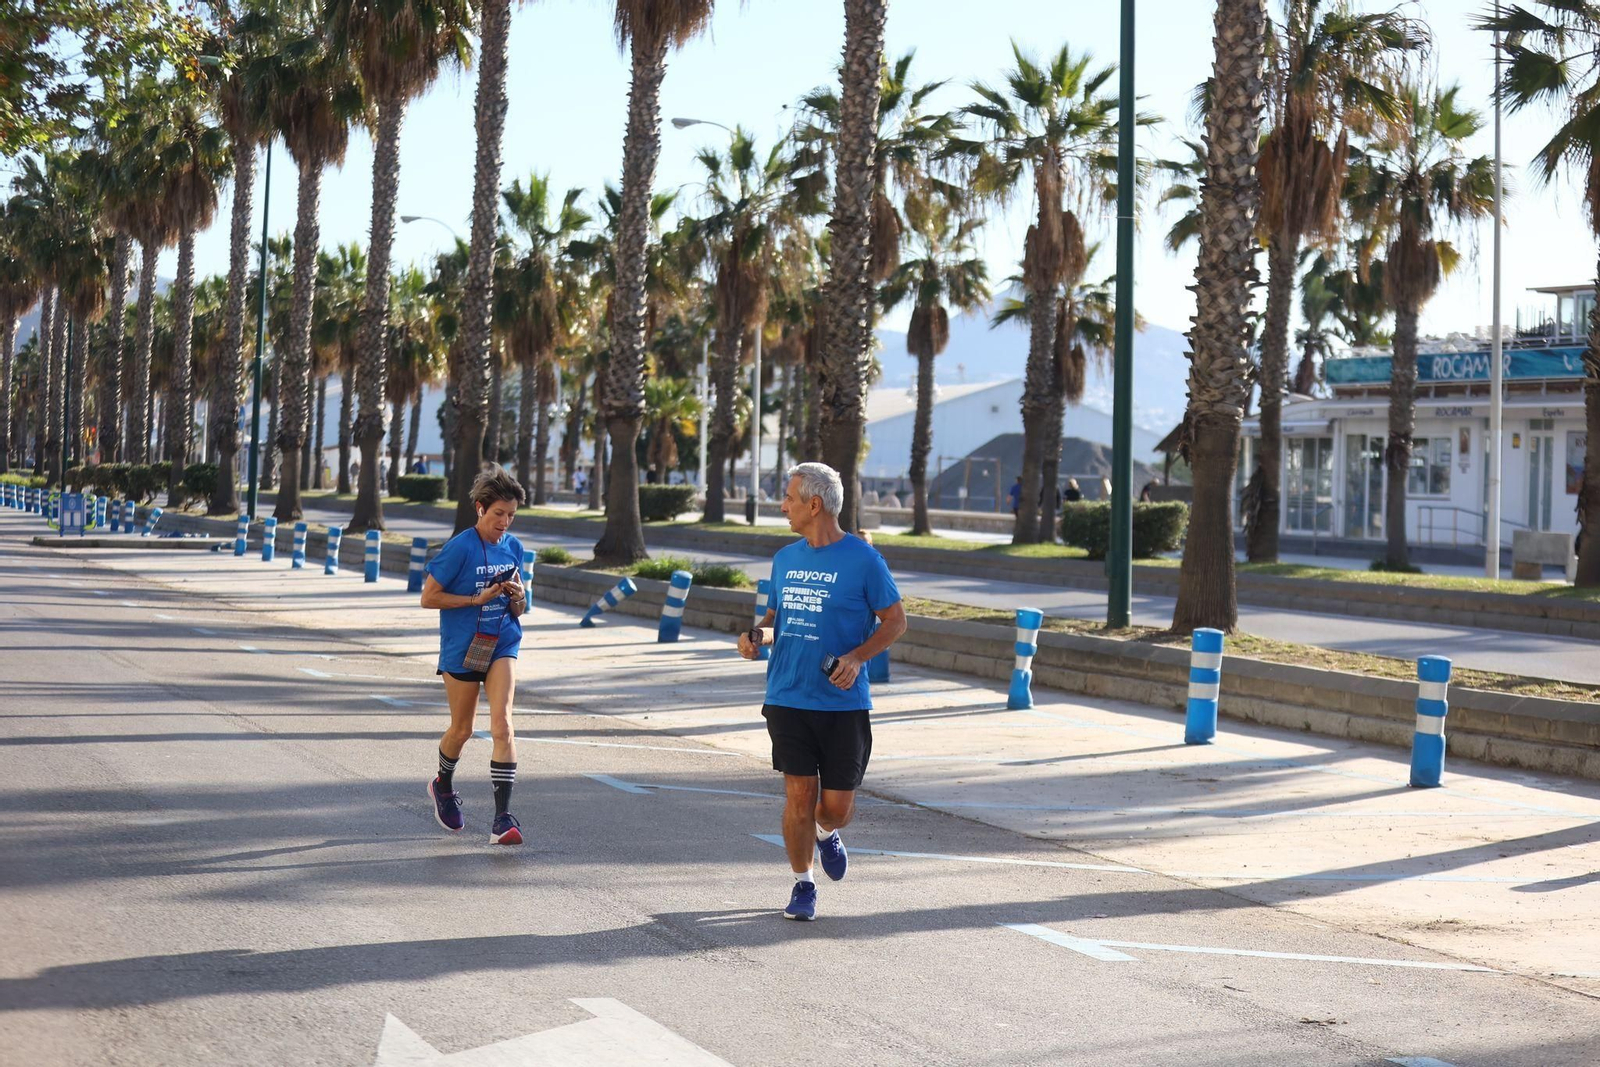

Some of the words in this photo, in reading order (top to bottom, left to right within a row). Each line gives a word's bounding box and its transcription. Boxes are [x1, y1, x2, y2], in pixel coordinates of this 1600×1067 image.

[1433, 354, 1511, 378] ROCAMR
[785, 570, 838, 583] mayoral
[783, 595, 822, 604] MAKES
[783, 602, 823, 612] FRIENDS
